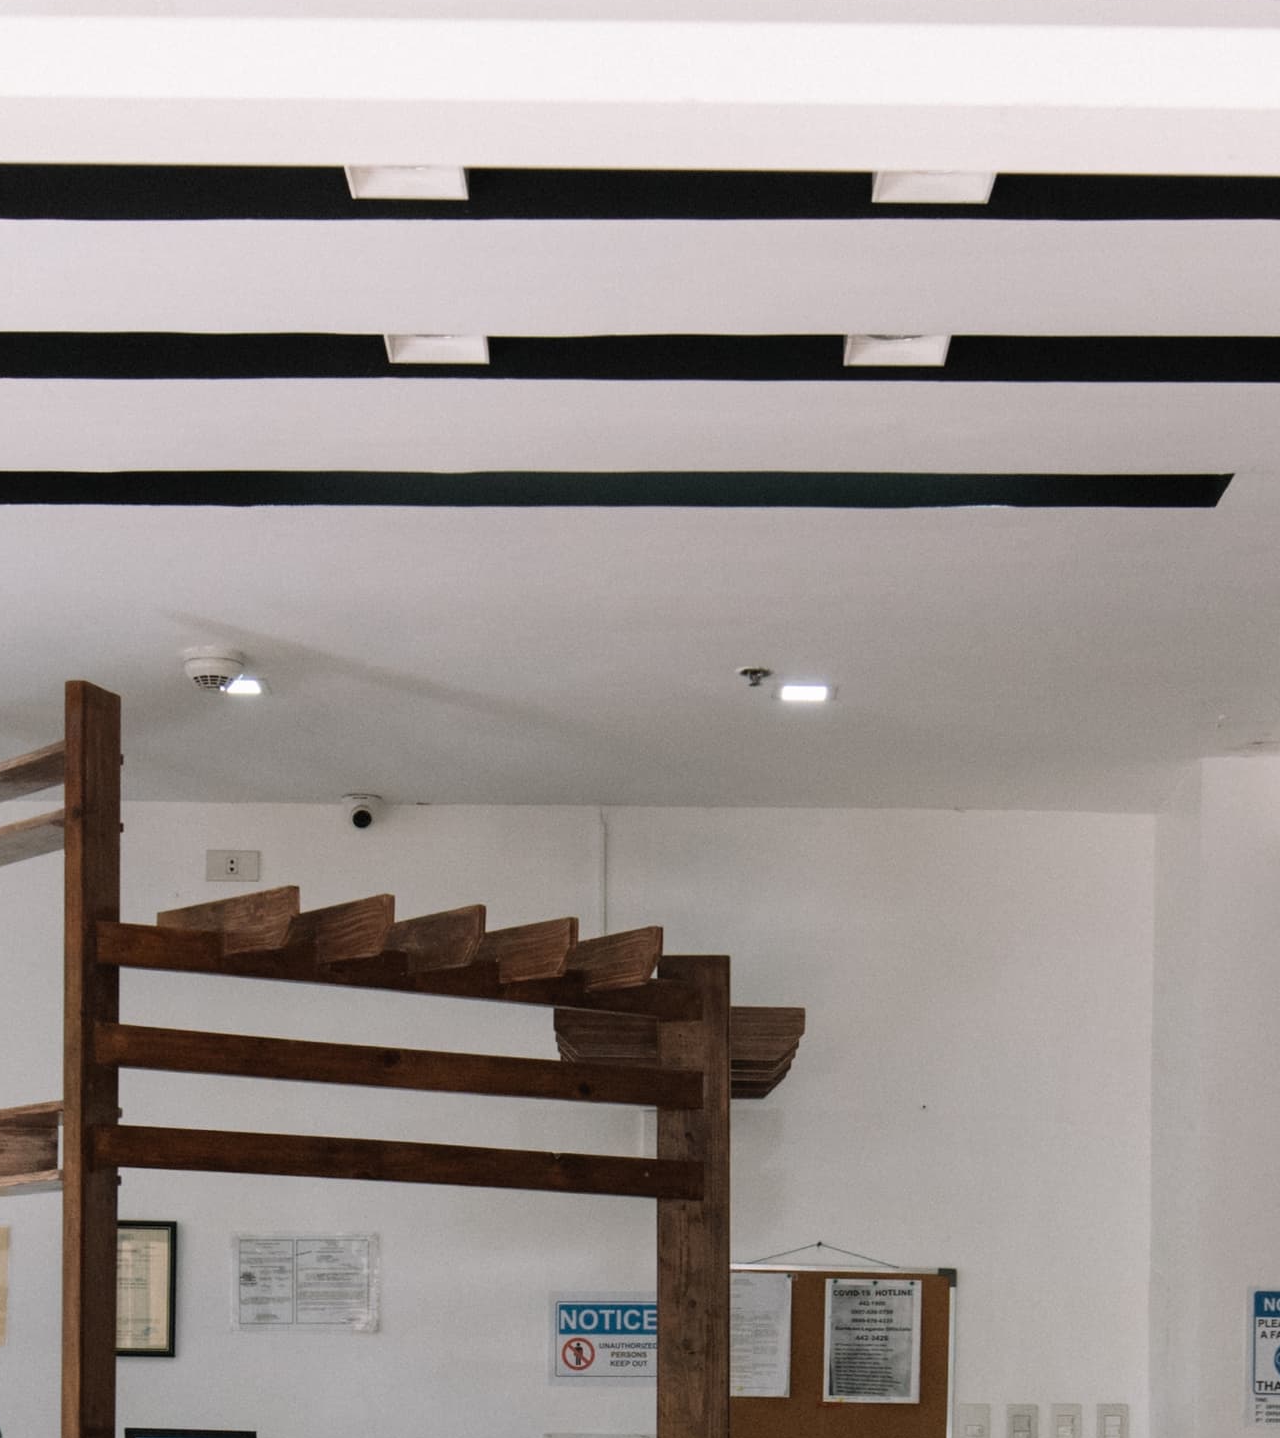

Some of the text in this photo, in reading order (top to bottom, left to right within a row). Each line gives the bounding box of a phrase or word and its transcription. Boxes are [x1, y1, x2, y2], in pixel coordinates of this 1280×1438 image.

[875, 1289, 913, 1297] HOTLINE
[560, 1309, 657, 1330] NOTICE
[1260, 1331, 1268, 1339] A
